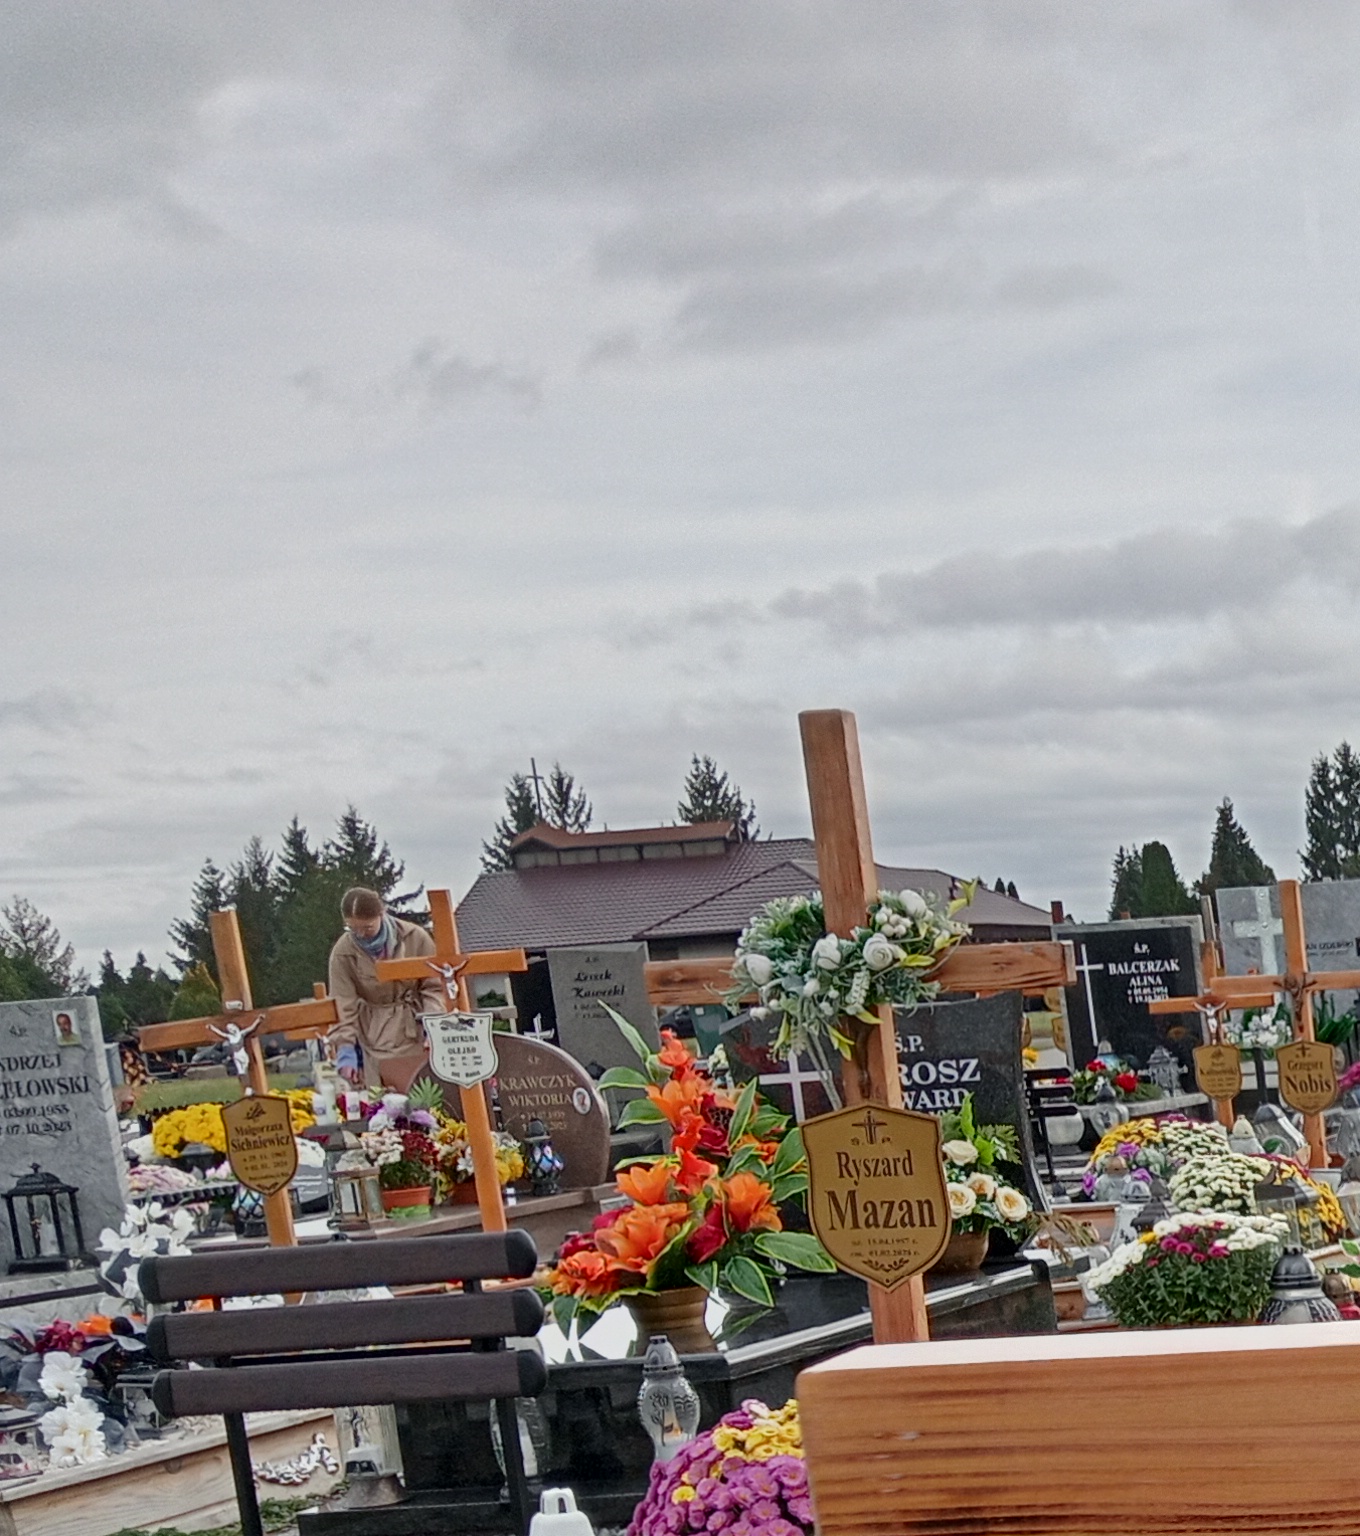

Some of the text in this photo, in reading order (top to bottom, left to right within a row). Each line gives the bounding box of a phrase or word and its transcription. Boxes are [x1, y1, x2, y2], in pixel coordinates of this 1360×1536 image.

[1108, 958, 1180, 975] BALCERZAK
[1129, 974, 1163, 987] ALINA
[500, 1074, 578, 1090] KRAWCZYK
[1284, 1073, 1333, 1095] Nobis
[508, 1093, 573, 1107] WIKTORIA
[836, 1150, 914, 1186] Ryszard
[824, 1189, 937, 1232] Mazan
